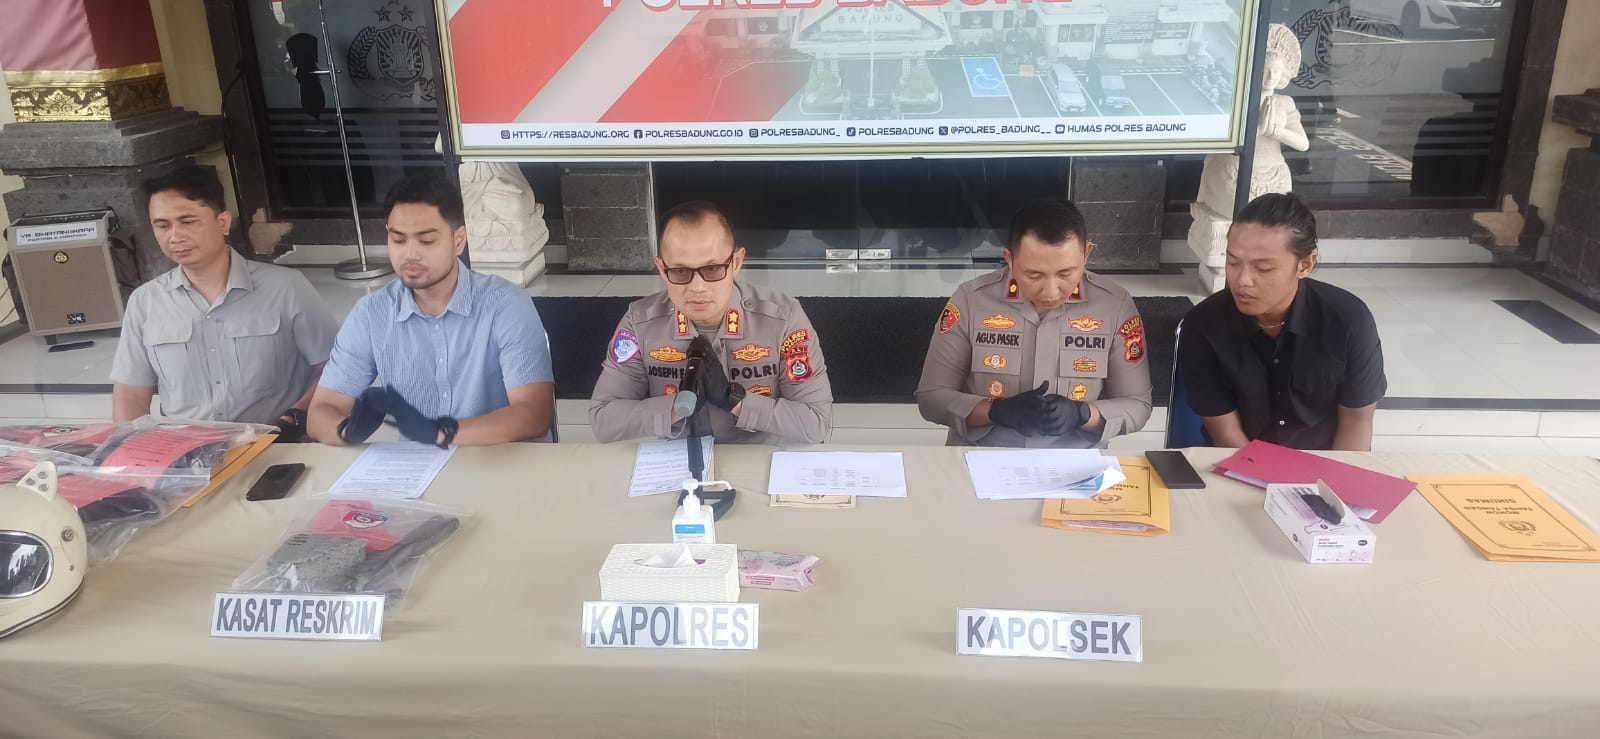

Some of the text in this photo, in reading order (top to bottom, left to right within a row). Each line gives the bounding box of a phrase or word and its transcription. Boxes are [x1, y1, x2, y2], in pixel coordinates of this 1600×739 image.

[512, 130, 629, 139] HTTPS://RESBADUNG.ORG
[761, 128, 840, 137] POLRESBADUNG_
[858, 127, 934, 136] POLRESBADUNG
[1067, 123, 1187, 133] HUMAS POLRES BADUNG
[975, 331, 1020, 347] AGUS PASEK
[1064, 335, 1106, 349] POLRI
[648, 365, 678, 379] JOSEPH
[731, 363, 778, 380] POLRI
[216, 597, 377, 635] KASAT RESKRIM
[590, 605, 749, 647] KAPOLRES
[967, 615, 1132, 655] KAPOLSEK
